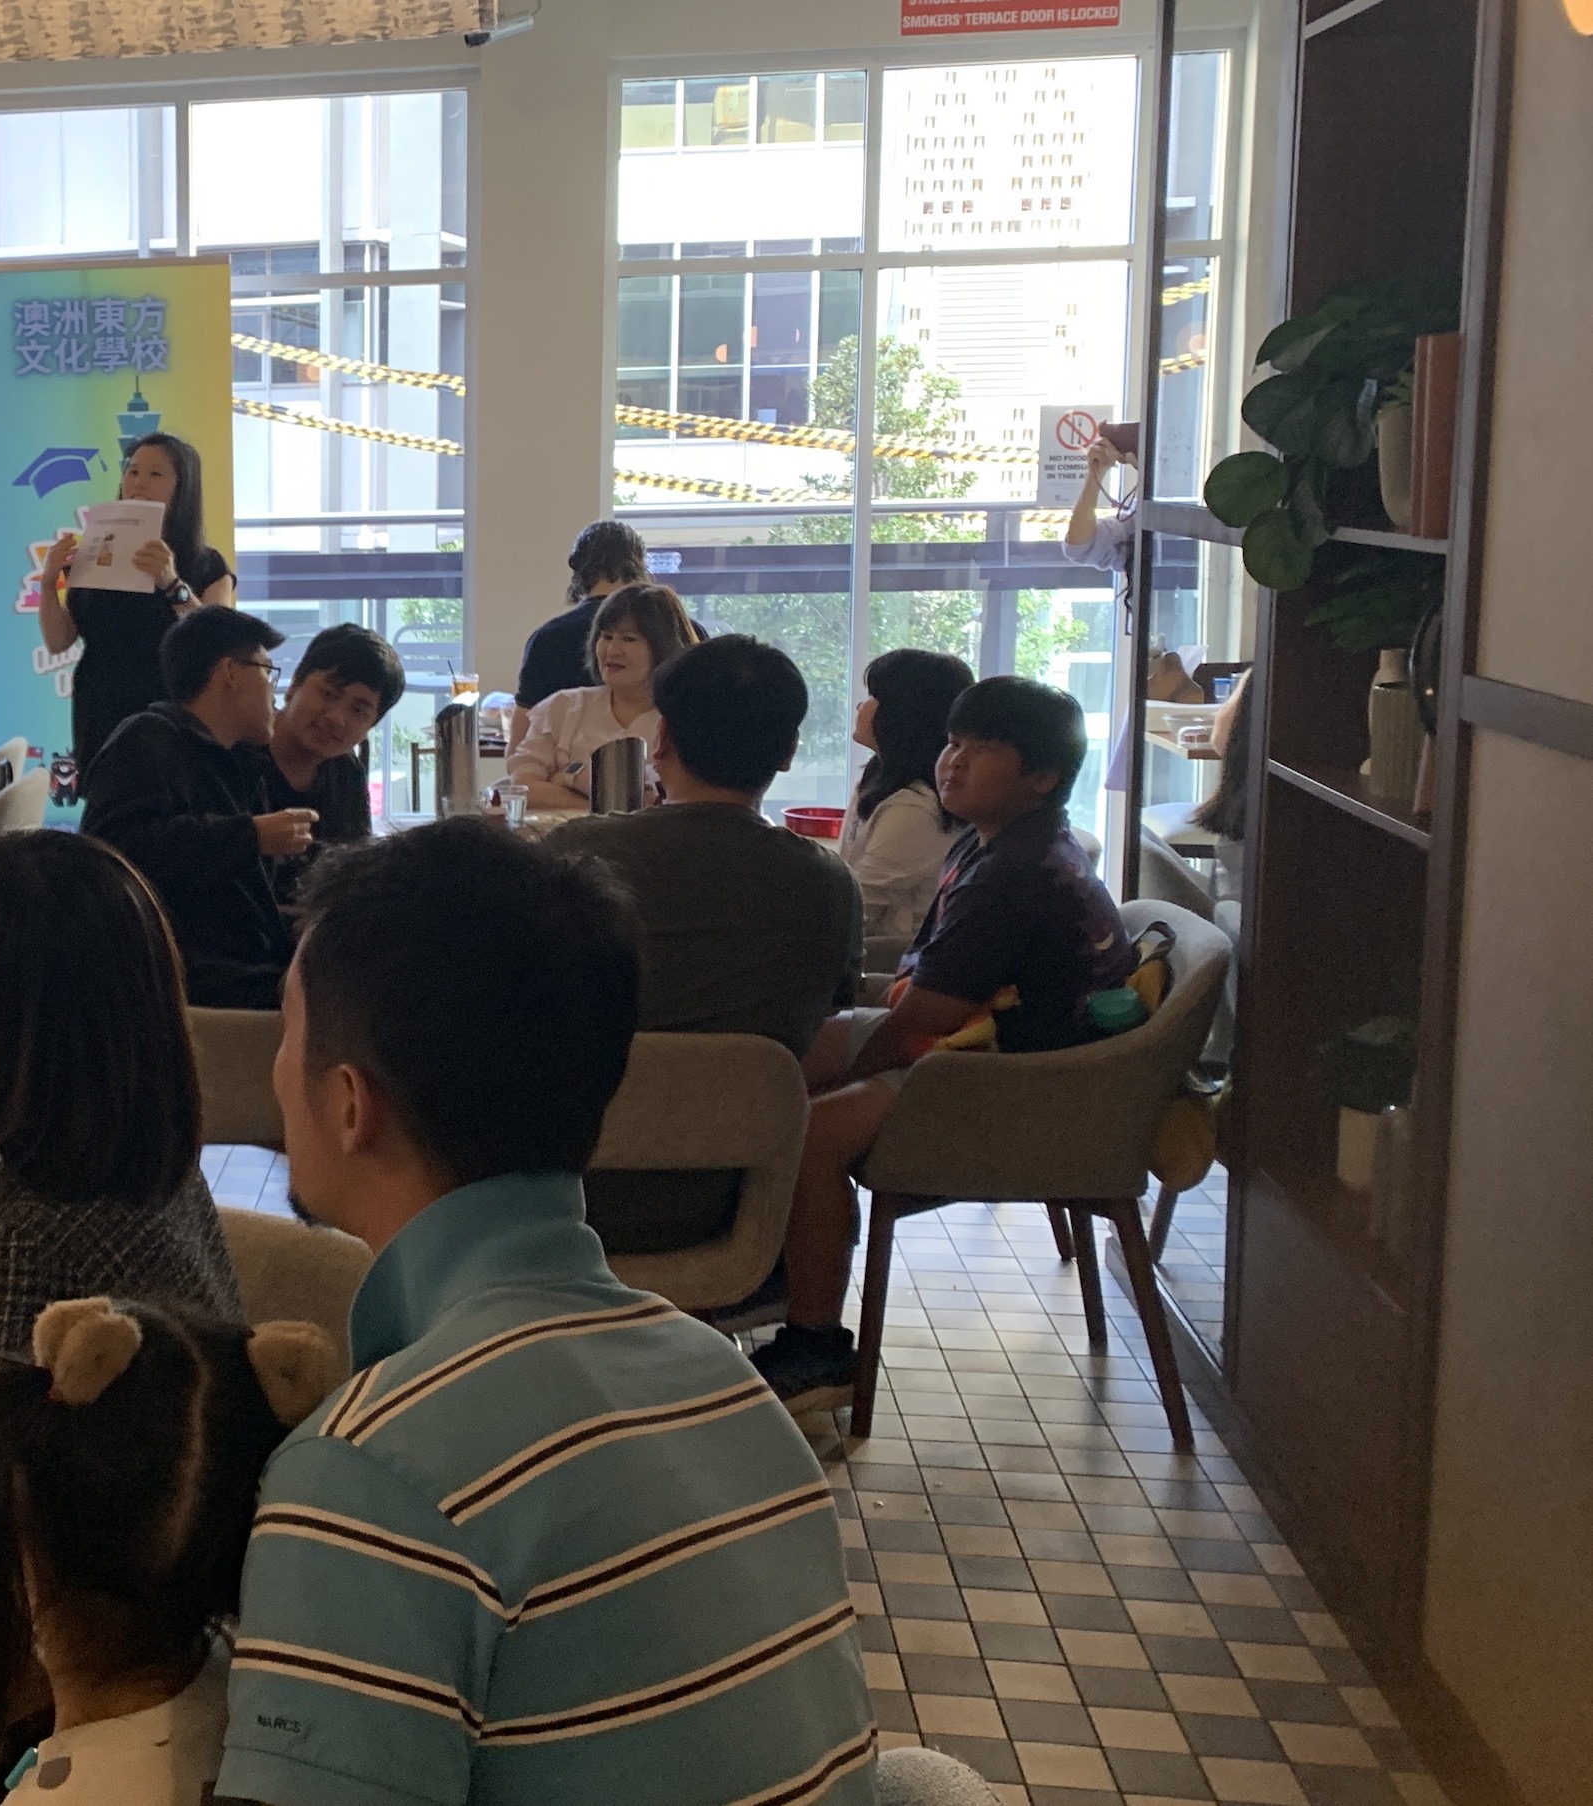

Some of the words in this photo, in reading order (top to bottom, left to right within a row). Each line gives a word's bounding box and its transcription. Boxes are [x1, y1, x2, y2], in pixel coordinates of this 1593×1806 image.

[902, 13, 963, 28] SMOKERS'
[965, 10, 1018, 25] TERRACE
[1020, 9, 1055, 23] DOOR
[1057, 8, 1069, 21] IS
[1071, 6, 1119, 20] LOCKED
[14, 296, 167, 337] 澳洲東方
[15, 335, 168, 375] 文化學校
